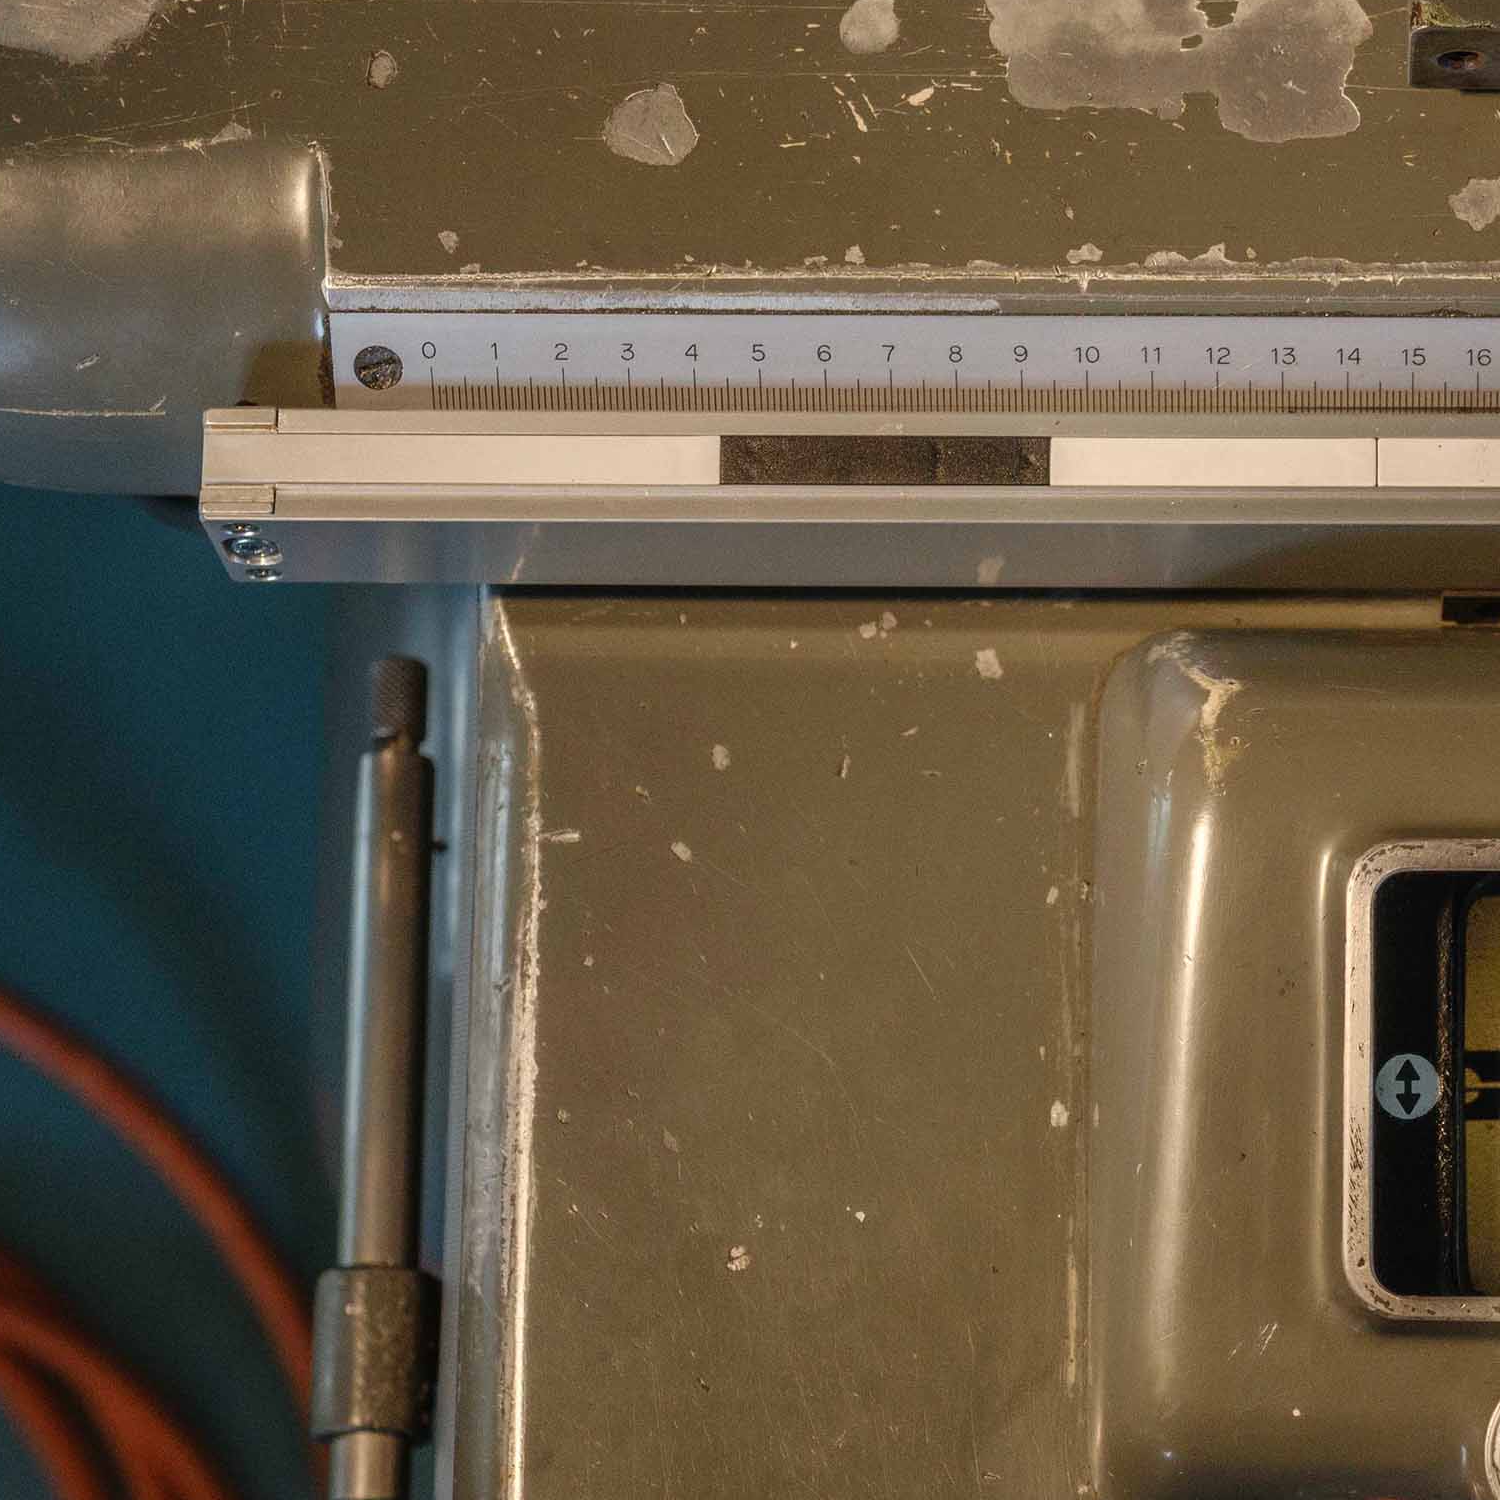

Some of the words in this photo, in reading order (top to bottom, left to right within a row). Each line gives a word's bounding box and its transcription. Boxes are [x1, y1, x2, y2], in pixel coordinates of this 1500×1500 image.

[421, 340, 437, 359] 0
[490, 342, 498, 360] 1
[554, 342, 569, 360] 2
[620, 342, 635, 361] 3
[684, 343, 699, 361] 4
[751, 343, 767, 362] 5
[816, 344, 832, 362] 6
[881, 344, 896, 362] 7
[948, 344, 964, 363] 8
[1013, 344, 1029, 363] 9
[1075, 345, 1100, 363] 10
[1140, 345, 1161, 364] 11
[1205, 346, 1231, 364] 12
[1271, 347, 1297, 365] 13
[1336, 347, 1362, 366] 14
[1401, 347, 1427, 366] 15
[1467, 348, 1492, 366] 16
